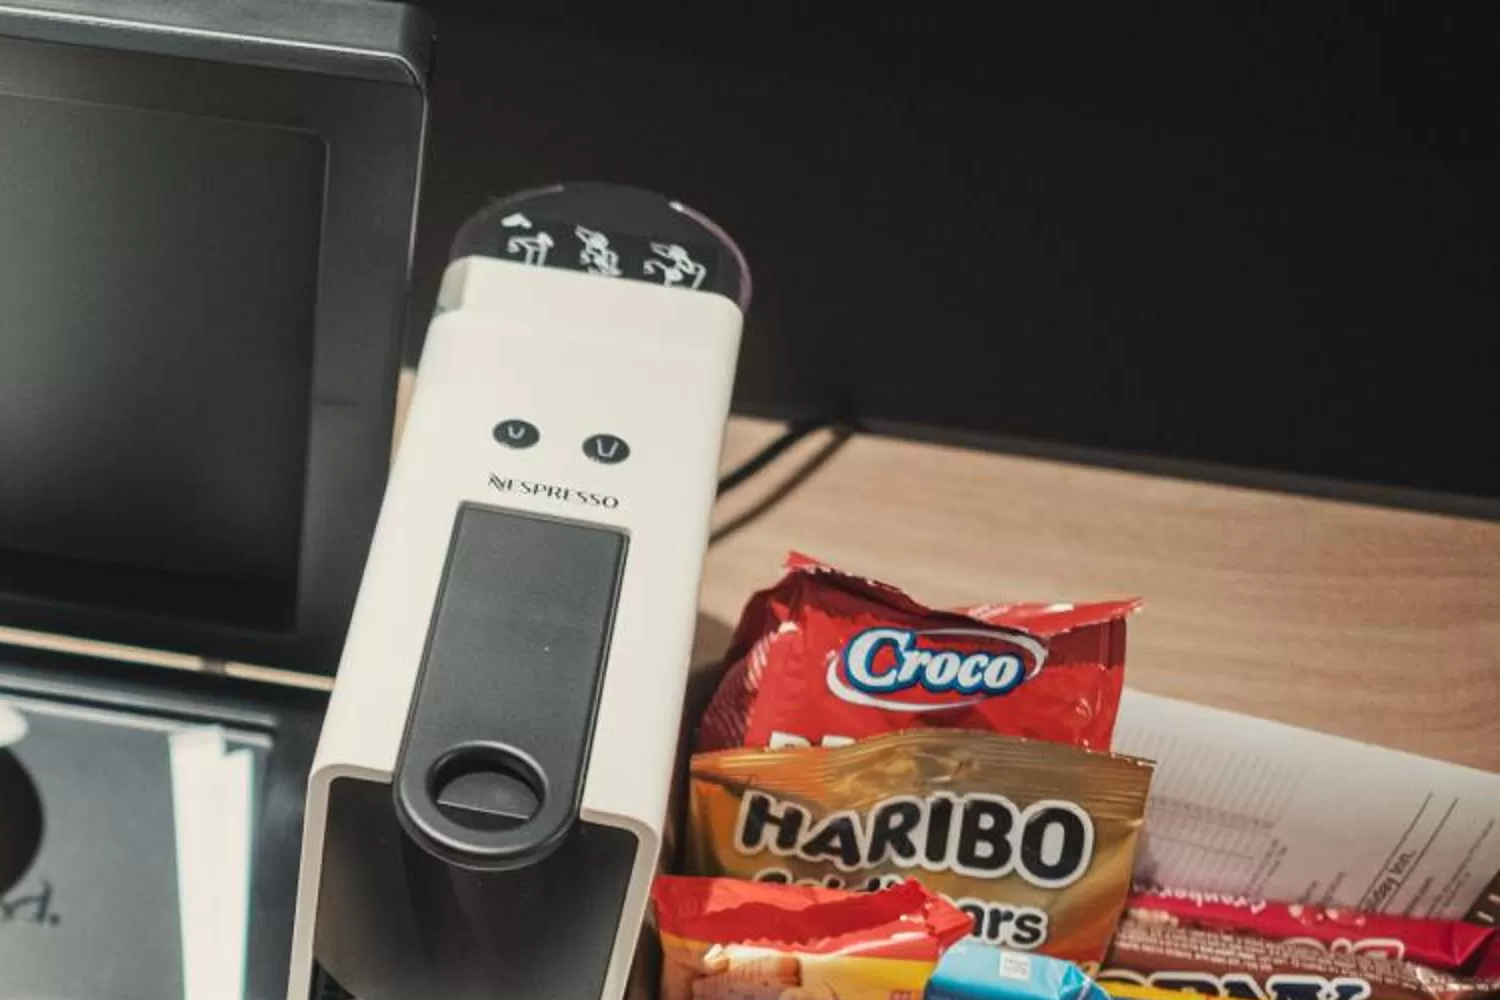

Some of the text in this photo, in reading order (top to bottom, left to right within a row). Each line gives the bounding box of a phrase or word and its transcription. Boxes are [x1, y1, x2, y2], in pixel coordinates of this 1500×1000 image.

[487, 473, 620, 510] NESPRESSO
[846, 629, 1025, 693] Croco
[736, 791, 1093, 887] HARIBO
